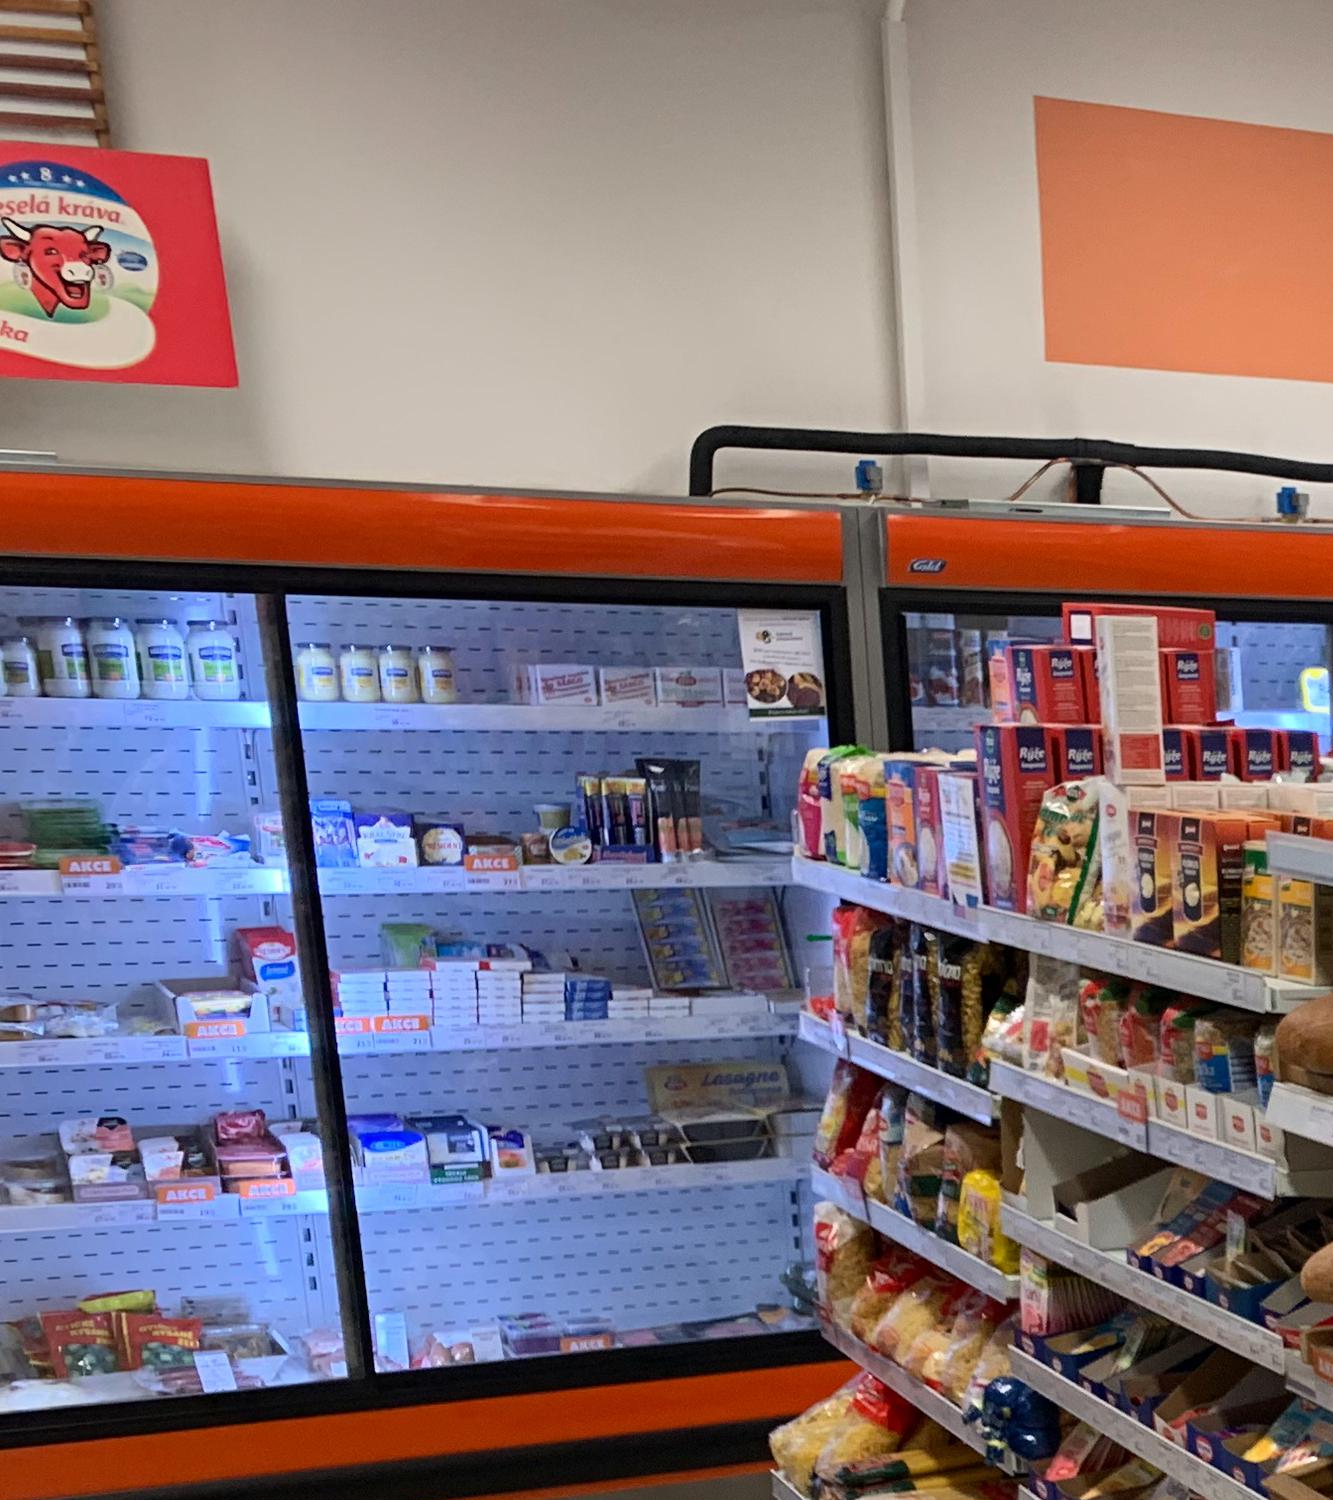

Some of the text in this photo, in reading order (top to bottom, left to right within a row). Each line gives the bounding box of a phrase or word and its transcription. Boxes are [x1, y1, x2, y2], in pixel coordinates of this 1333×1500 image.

[40, 167, 52, 181] 8
[0, 193, 121, 224] selá kráva
[69, 859, 112, 873] AKCE
[471, 856, 512, 871] AKCE
[165, 1188, 206, 1201] AKCE
